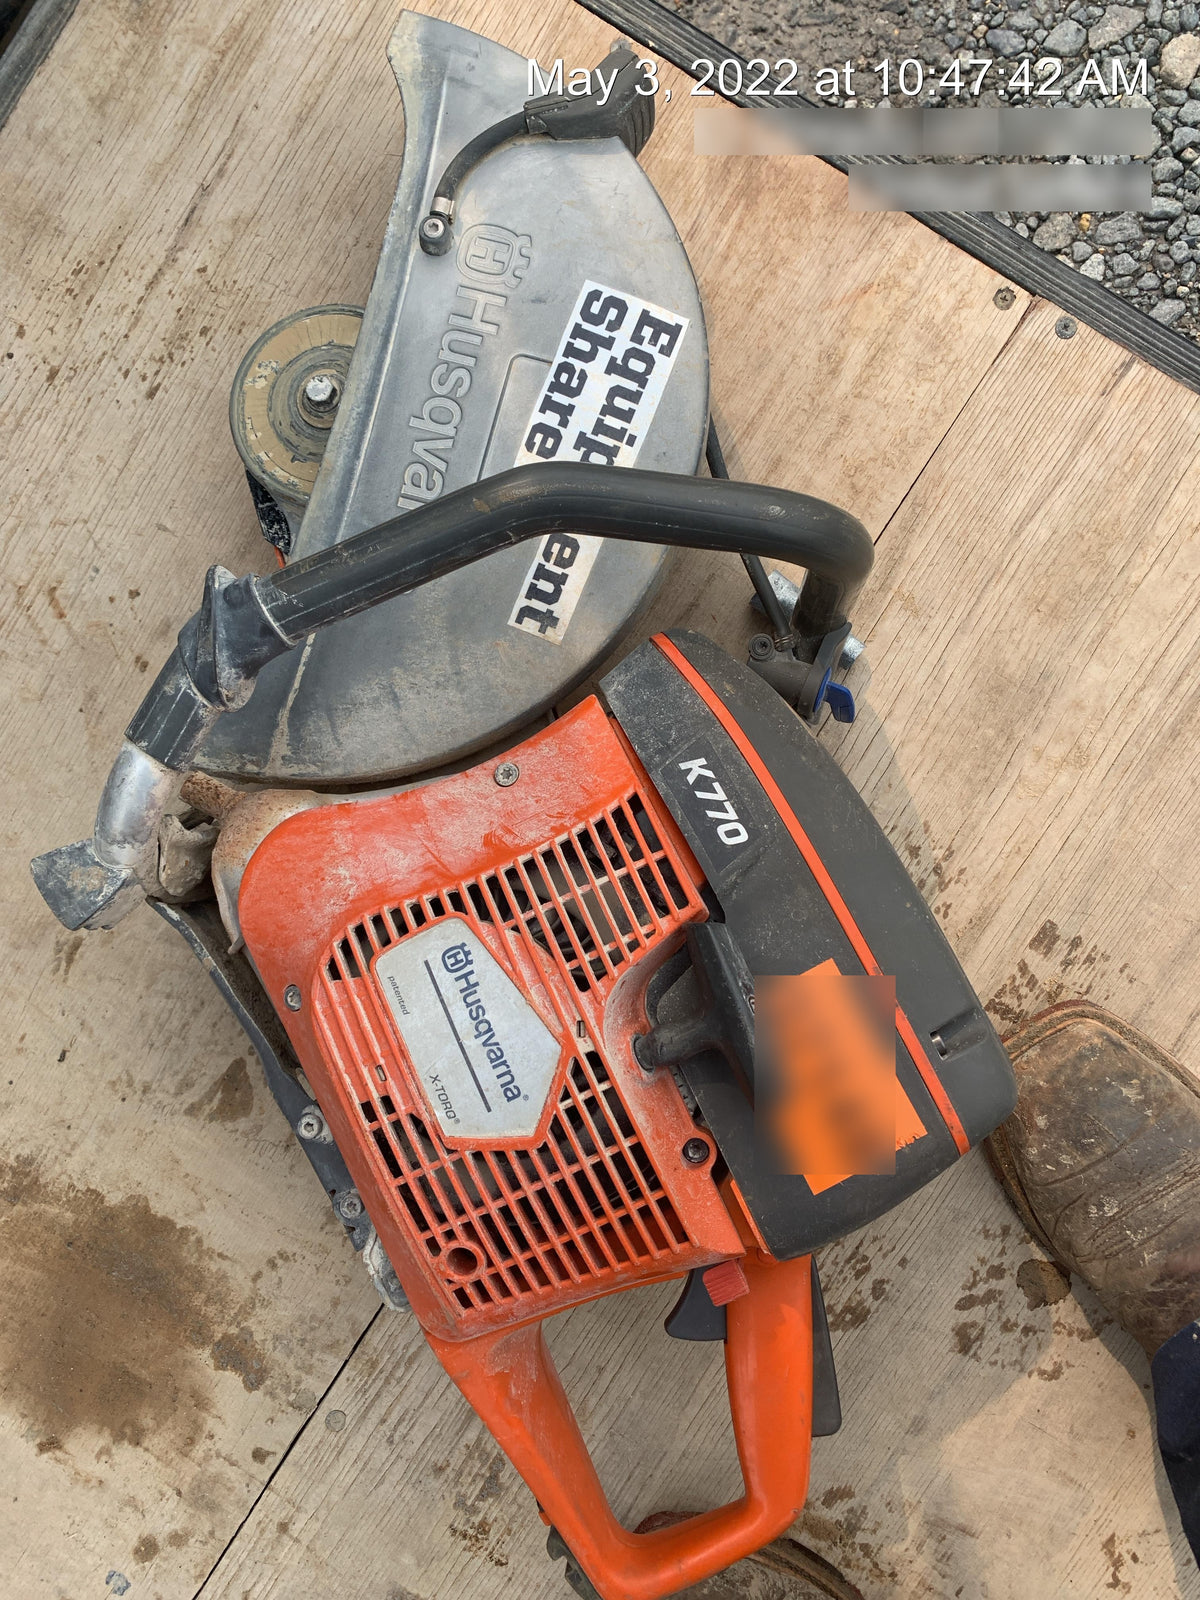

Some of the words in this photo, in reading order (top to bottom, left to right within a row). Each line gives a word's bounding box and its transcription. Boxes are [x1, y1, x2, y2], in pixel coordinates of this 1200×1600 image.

[524, 289, 629, 460] Share
[514, 308, 683, 634] Equipent
[678, 757, 749, 846] K770
[387, 975, 410, 1015] patented
